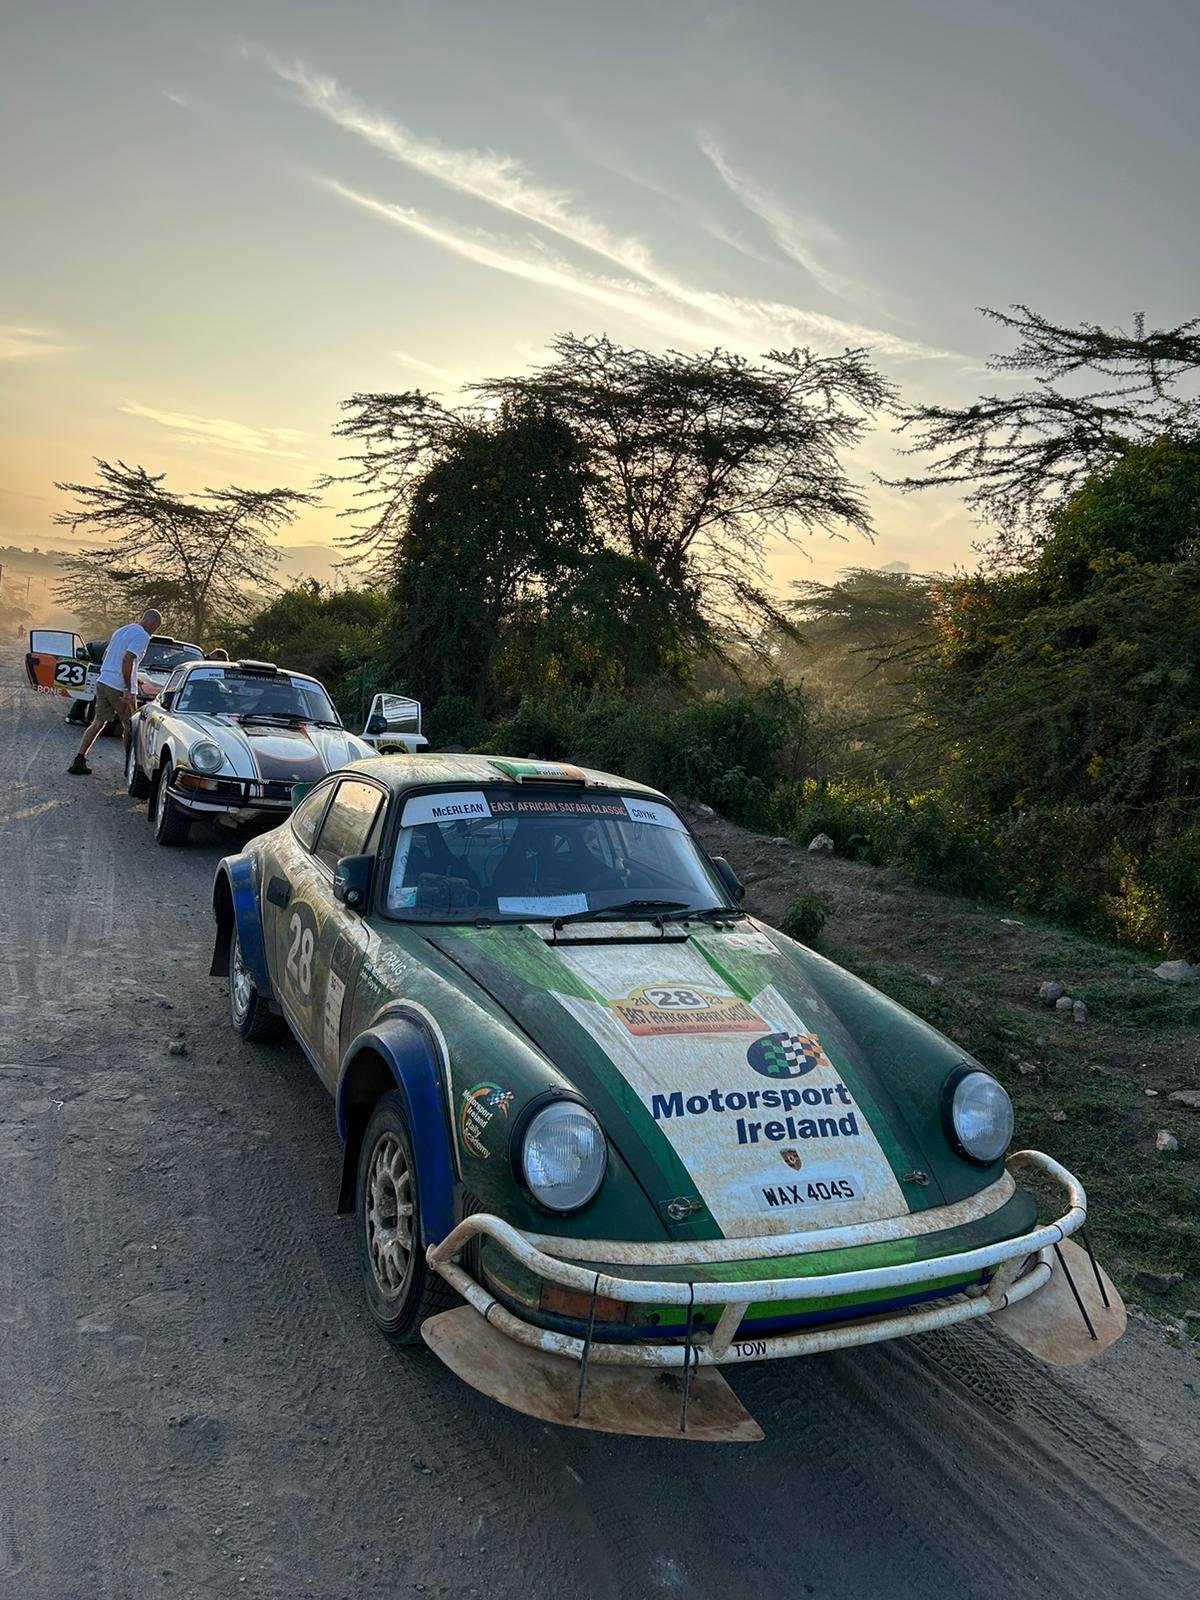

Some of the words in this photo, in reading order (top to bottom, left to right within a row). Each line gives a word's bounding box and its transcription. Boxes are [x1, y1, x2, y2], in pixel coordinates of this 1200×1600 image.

[56, 664, 84, 684] 23
[432, 803, 485, 818] McERLEAN
[491, 802, 516, 812] EAST
[518, 802, 558, 812] AFRICAN
[559, 802, 591, 813] SAFARI
[592, 804, 628, 816] CLASSIC
[631, 808, 658, 821] COYNE
[286, 912, 315, 996] 28
[381, 950, 407, 976] CRAIG
[631, 997, 650, 1007] 20
[650, 990, 702, 1006] 28
[617, 1005, 651, 1026] EAST
[649, 1009, 693, 1024] AFRICAN
[690, 1008, 723, 1023] SAFARI
[462, 1089, 493, 1121] Motorsport
[652, 1083, 852, 1120] Motorsport
[467, 1106, 488, 1128] Ireland
[465, 1118, 482, 1138] Rally
[736, 1112, 860, 1145] Ireland
[464, 1128, 491, 1159] Academy
[762, 1185, 803, 1207] WAX
[806, 1180, 855, 1201] 404S
[732, 1341, 767, 1357] TOW
